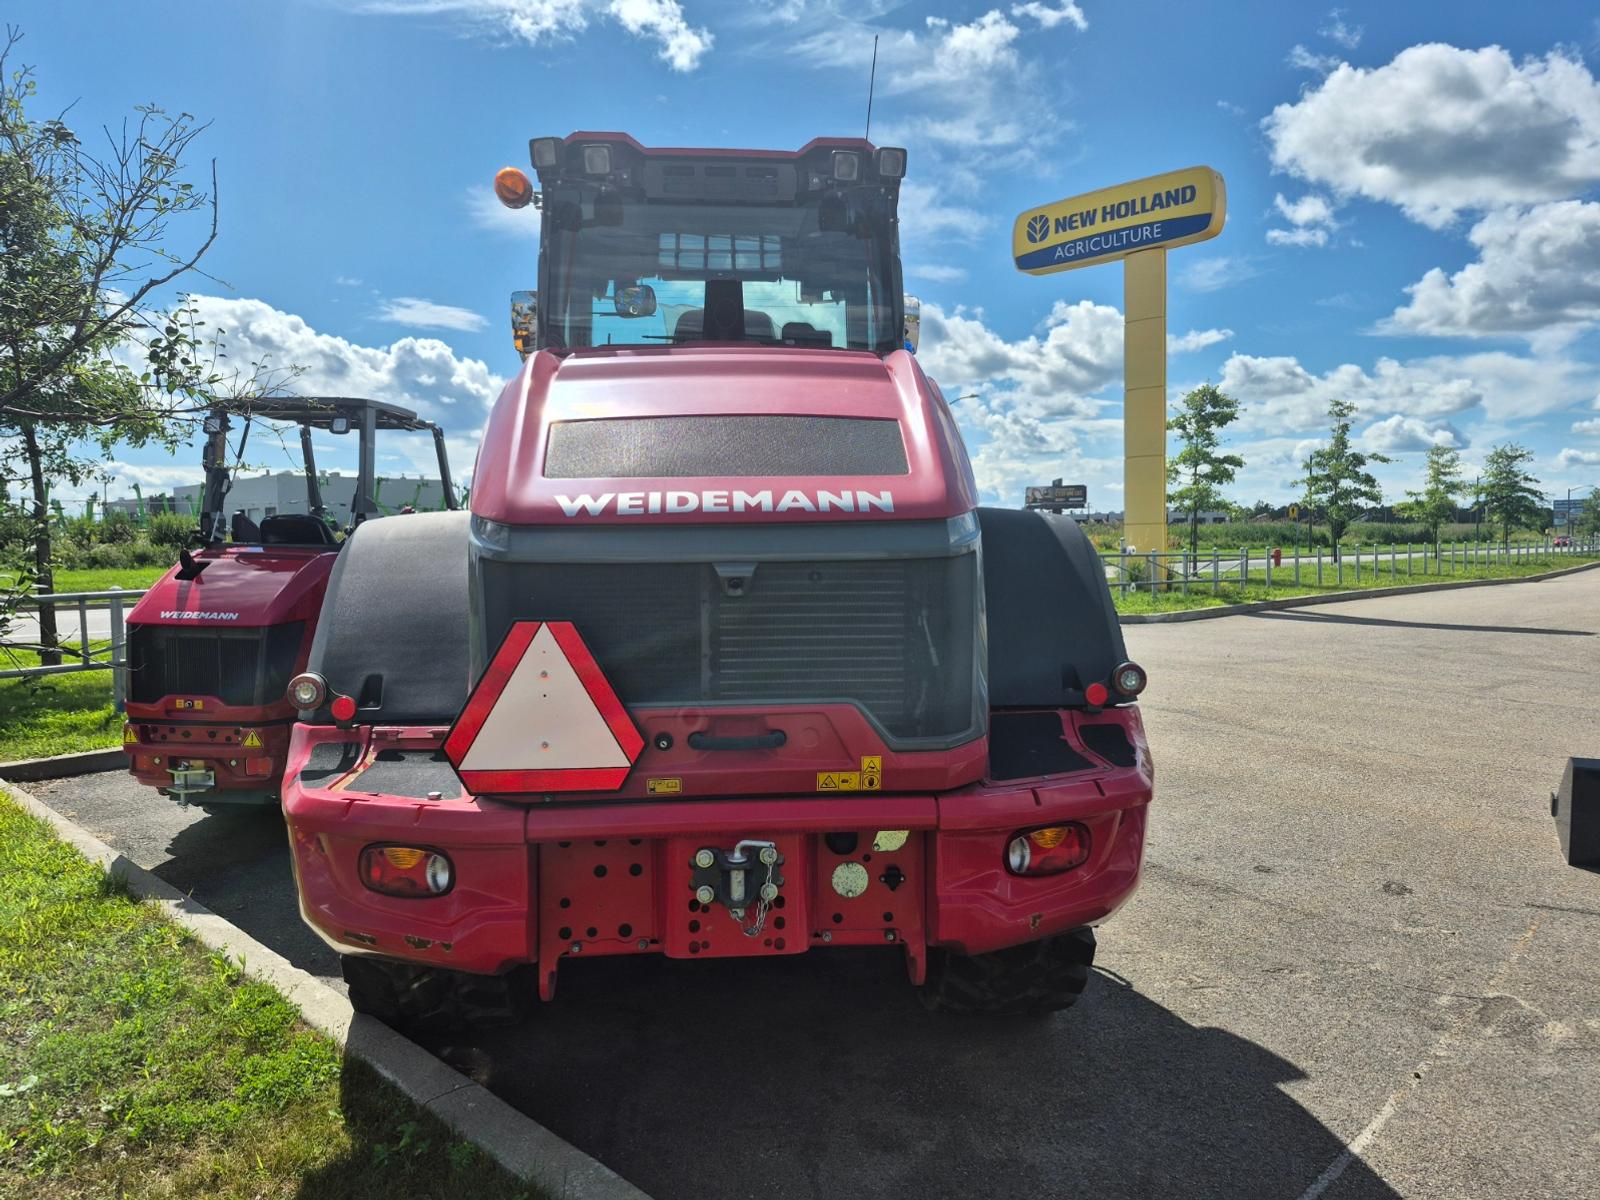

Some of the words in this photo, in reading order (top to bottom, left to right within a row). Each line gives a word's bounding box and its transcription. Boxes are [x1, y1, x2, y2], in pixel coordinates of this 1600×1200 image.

[1054, 208, 1098, 234] NEW
[1101, 184, 1197, 223] HOLLAND
[1054, 223, 1163, 260] AGRICULTURE
[553, 490, 895, 517] WEIDEMANN
[160, 610, 239, 620] WEIDEMANN
